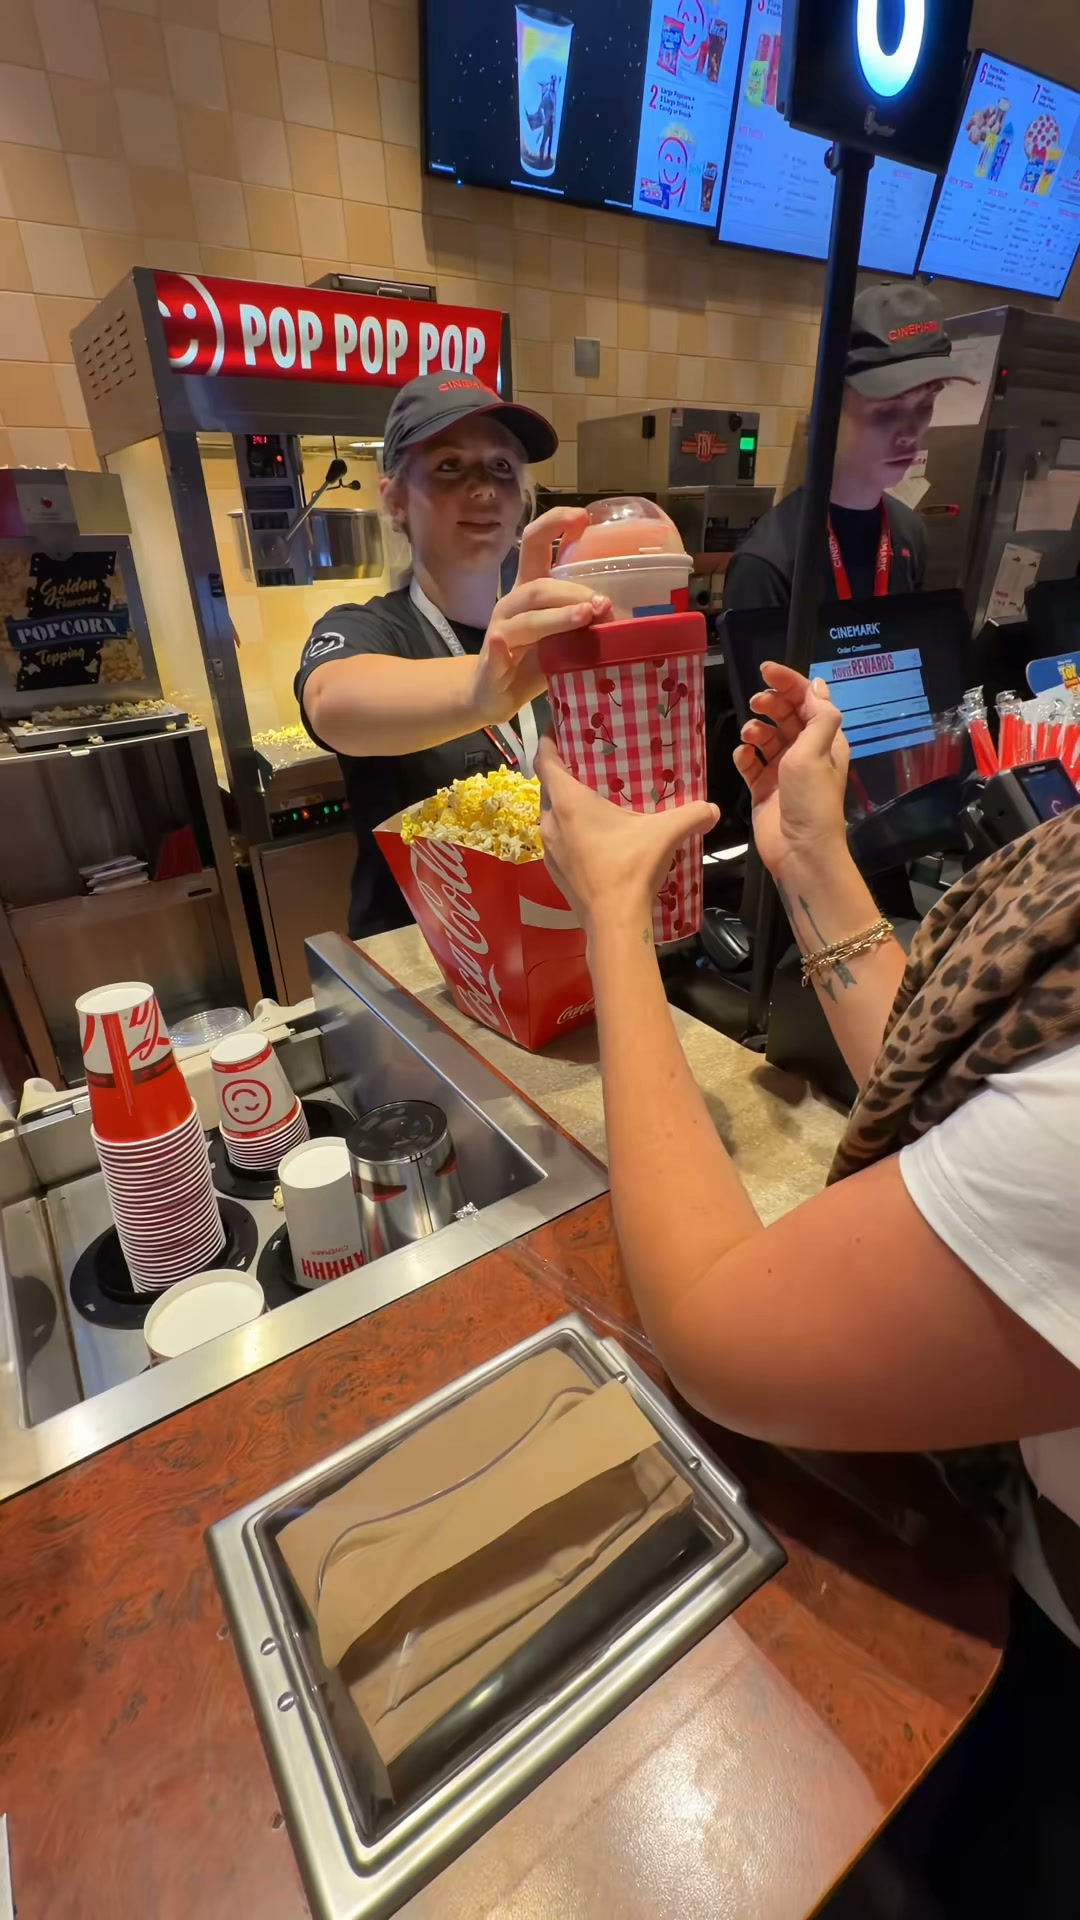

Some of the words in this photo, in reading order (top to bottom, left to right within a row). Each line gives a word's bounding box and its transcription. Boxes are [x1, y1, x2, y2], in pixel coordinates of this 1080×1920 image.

[979, 62, 988, 83] 6
[650, 85, 658, 109] 2
[1032, 84, 1040, 103] 7
[239, 304, 323, 370] POP
[334, 313, 408, 375] POP
[418, 322, 486, 376] POP
[40, 577, 98, 607] Golden
[16, 617, 117, 645] POPCORN
[829, 623, 880, 640] CINEMARK
[35, 647, 85, 667] Topping
[410, 838, 501, 1028] Coca-Cola
